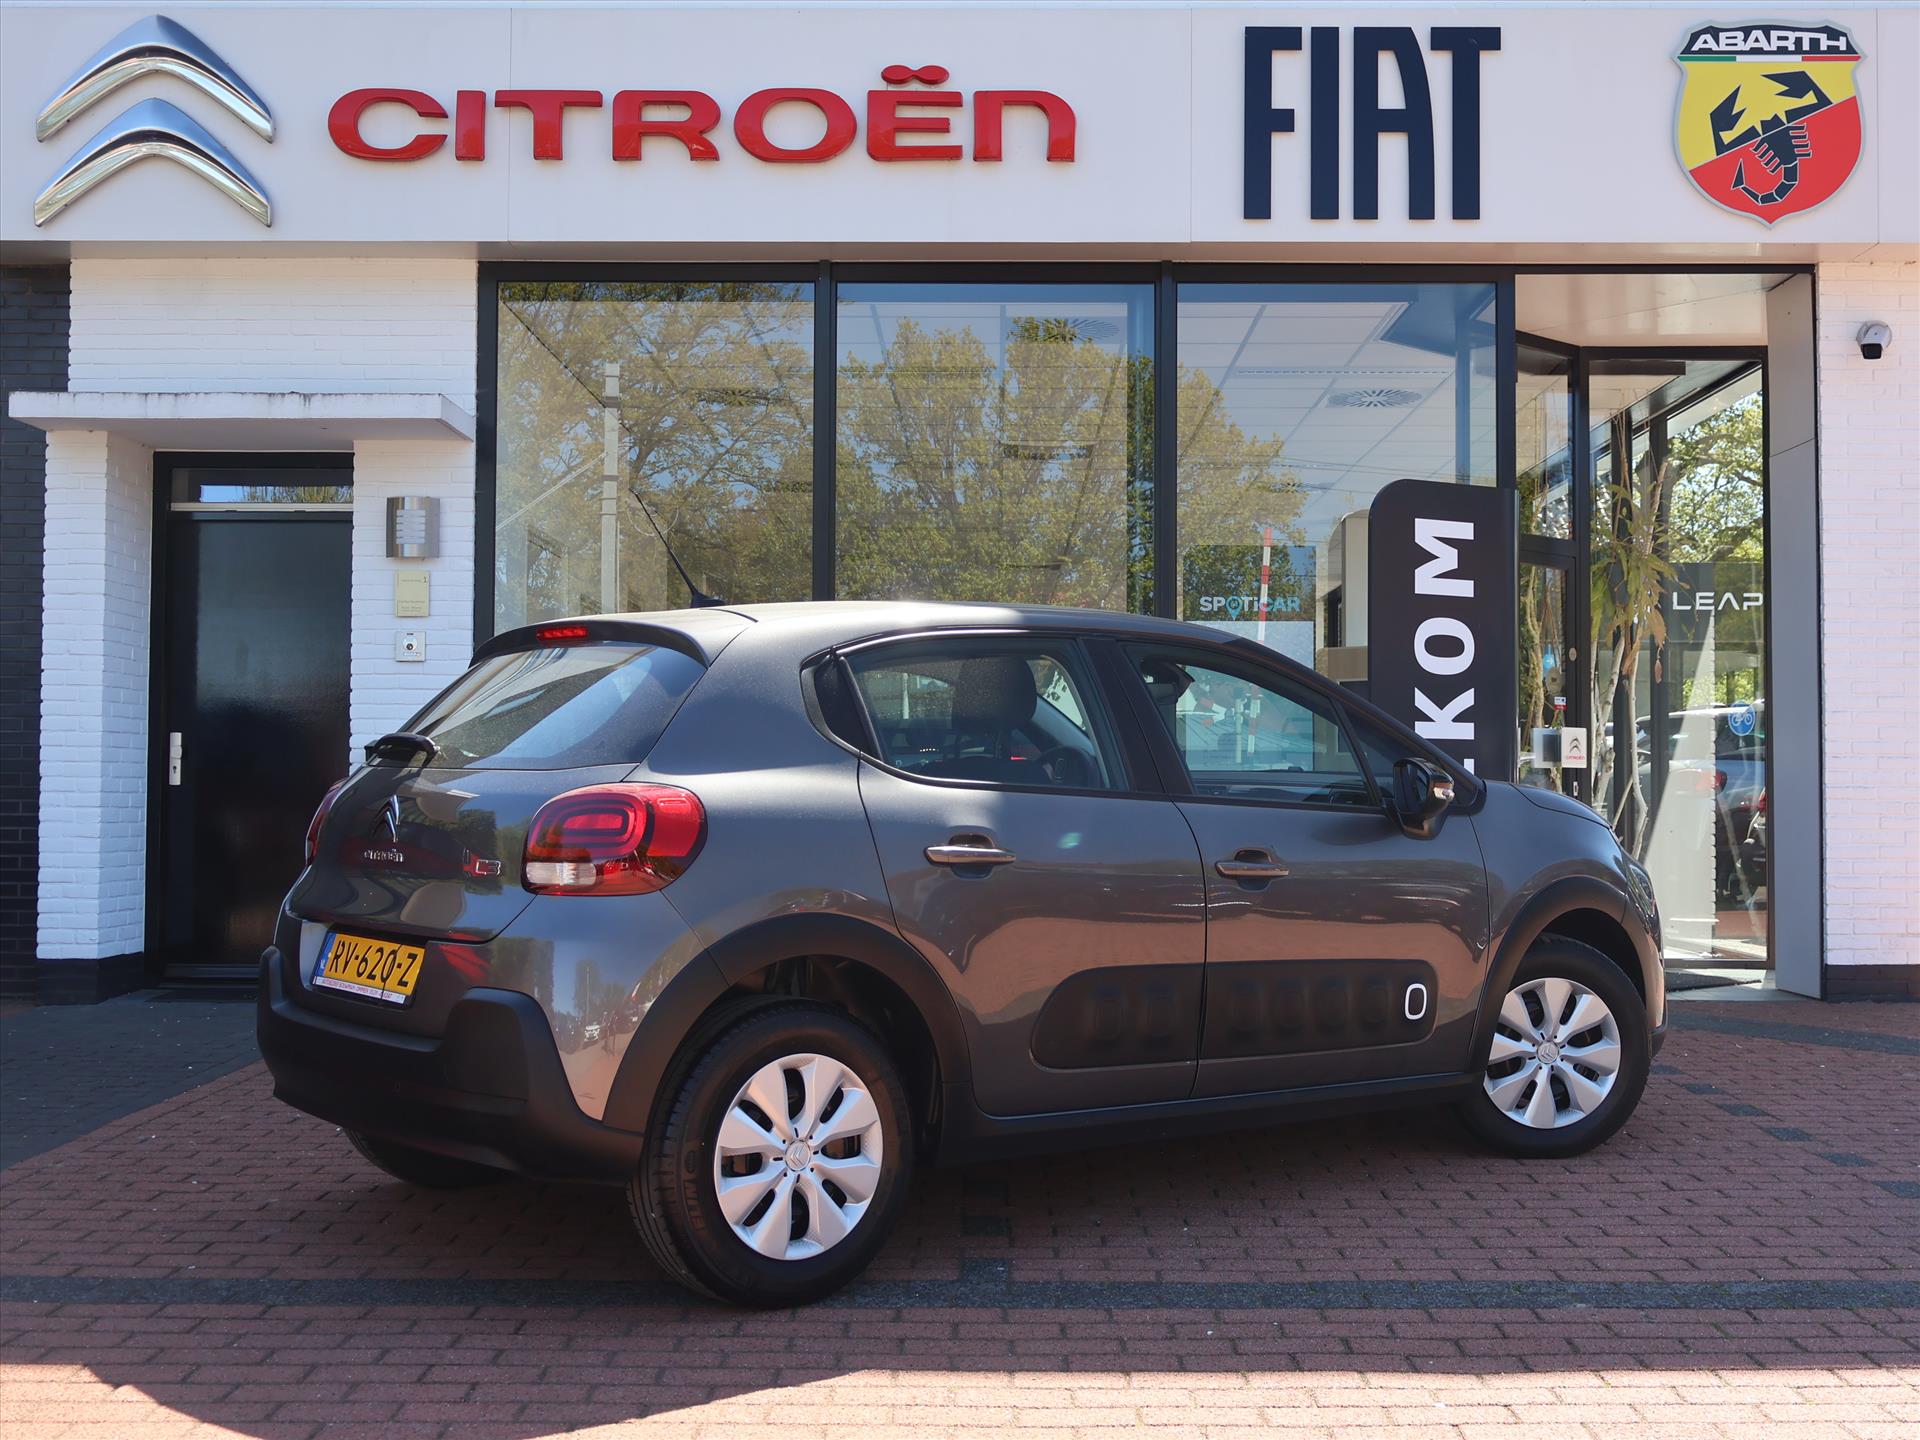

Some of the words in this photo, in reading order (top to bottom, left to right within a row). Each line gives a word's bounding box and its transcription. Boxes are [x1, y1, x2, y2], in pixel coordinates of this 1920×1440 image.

[1690, 29, 1847, 52] ABARTH
[1243, 26, 1502, 220] FIAT
[1672, 591, 1764, 611] LEAP
[1413, 517, 1475, 776] KOM
[328, 939, 419, 988] RV-620-Z
